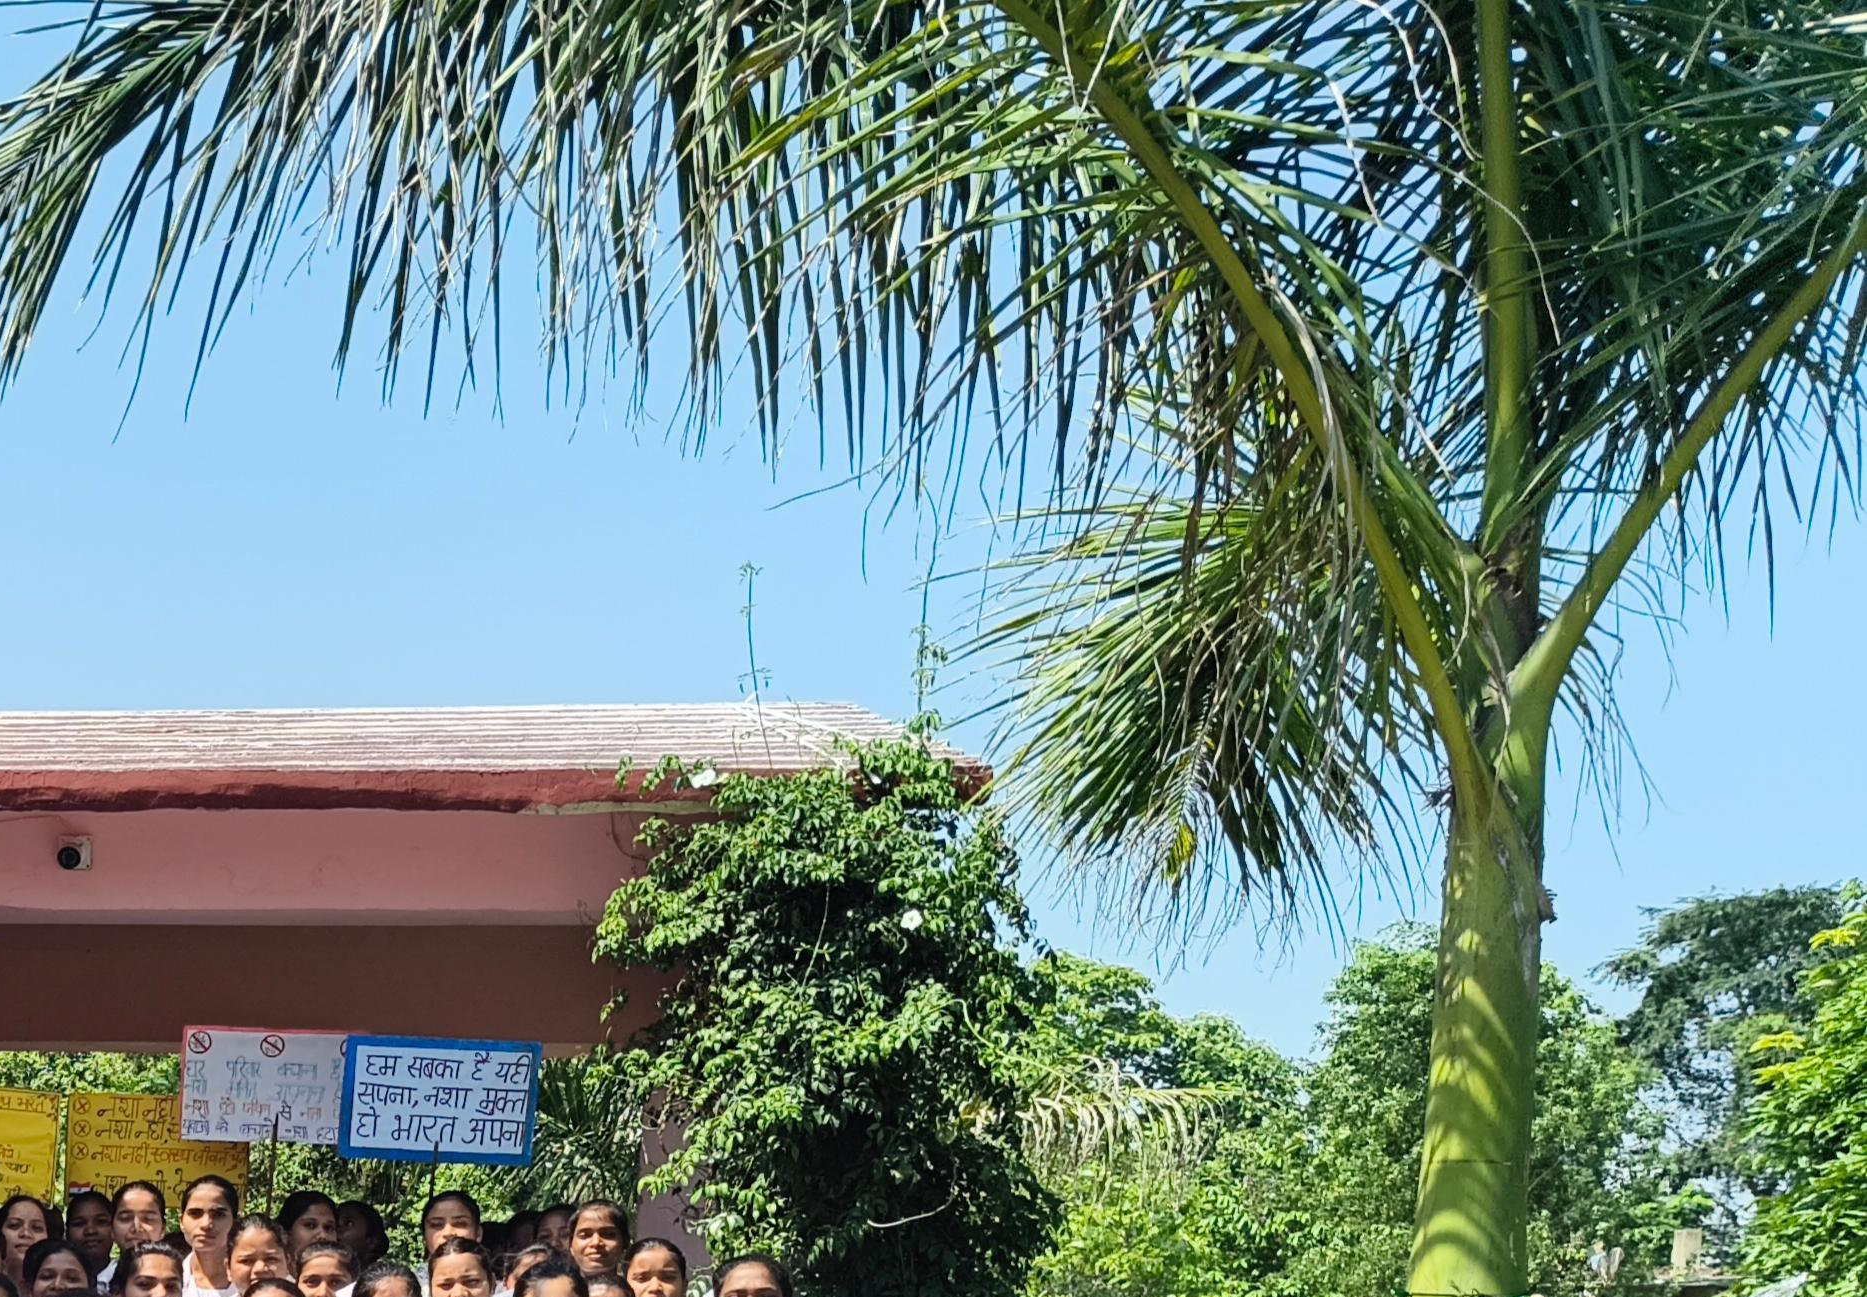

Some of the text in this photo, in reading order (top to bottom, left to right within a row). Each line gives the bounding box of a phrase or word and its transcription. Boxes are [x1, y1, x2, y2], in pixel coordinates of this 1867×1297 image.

[365, 1054, 403, 1077] हम
[407, 1056, 464, 1080] सबका
[494, 1054, 532, 1085] यही
[423, 1085, 474, 1110] नशा
[355, 1106, 526, 1148] हो भारत अपना
